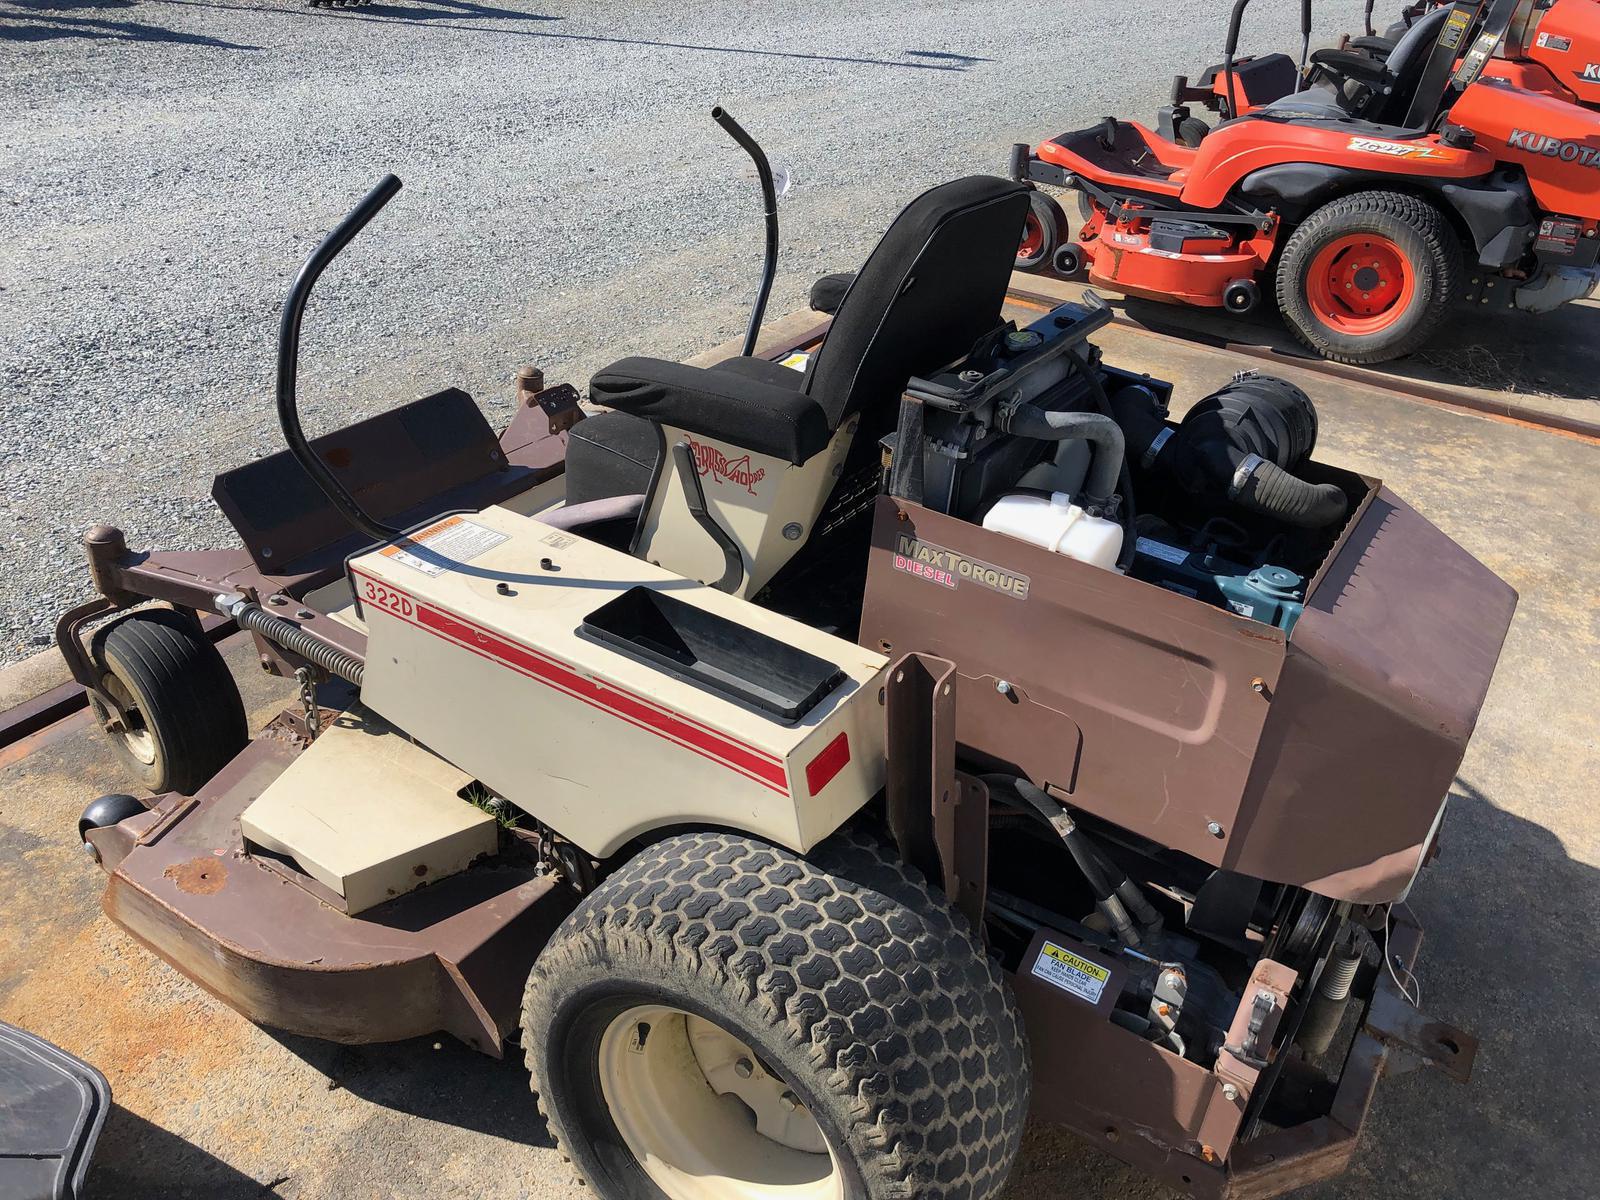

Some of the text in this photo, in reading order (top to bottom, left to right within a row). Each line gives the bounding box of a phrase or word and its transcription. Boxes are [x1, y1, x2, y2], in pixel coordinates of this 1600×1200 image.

[1507, 128, 1600, 169] KUBOTA
[895, 554, 955, 588] DIESEL
[366, 582, 413, 617] 322D
[1050, 958, 1091, 982] FAN BLADE
[1061, 953, 1099, 976] CAUTION
